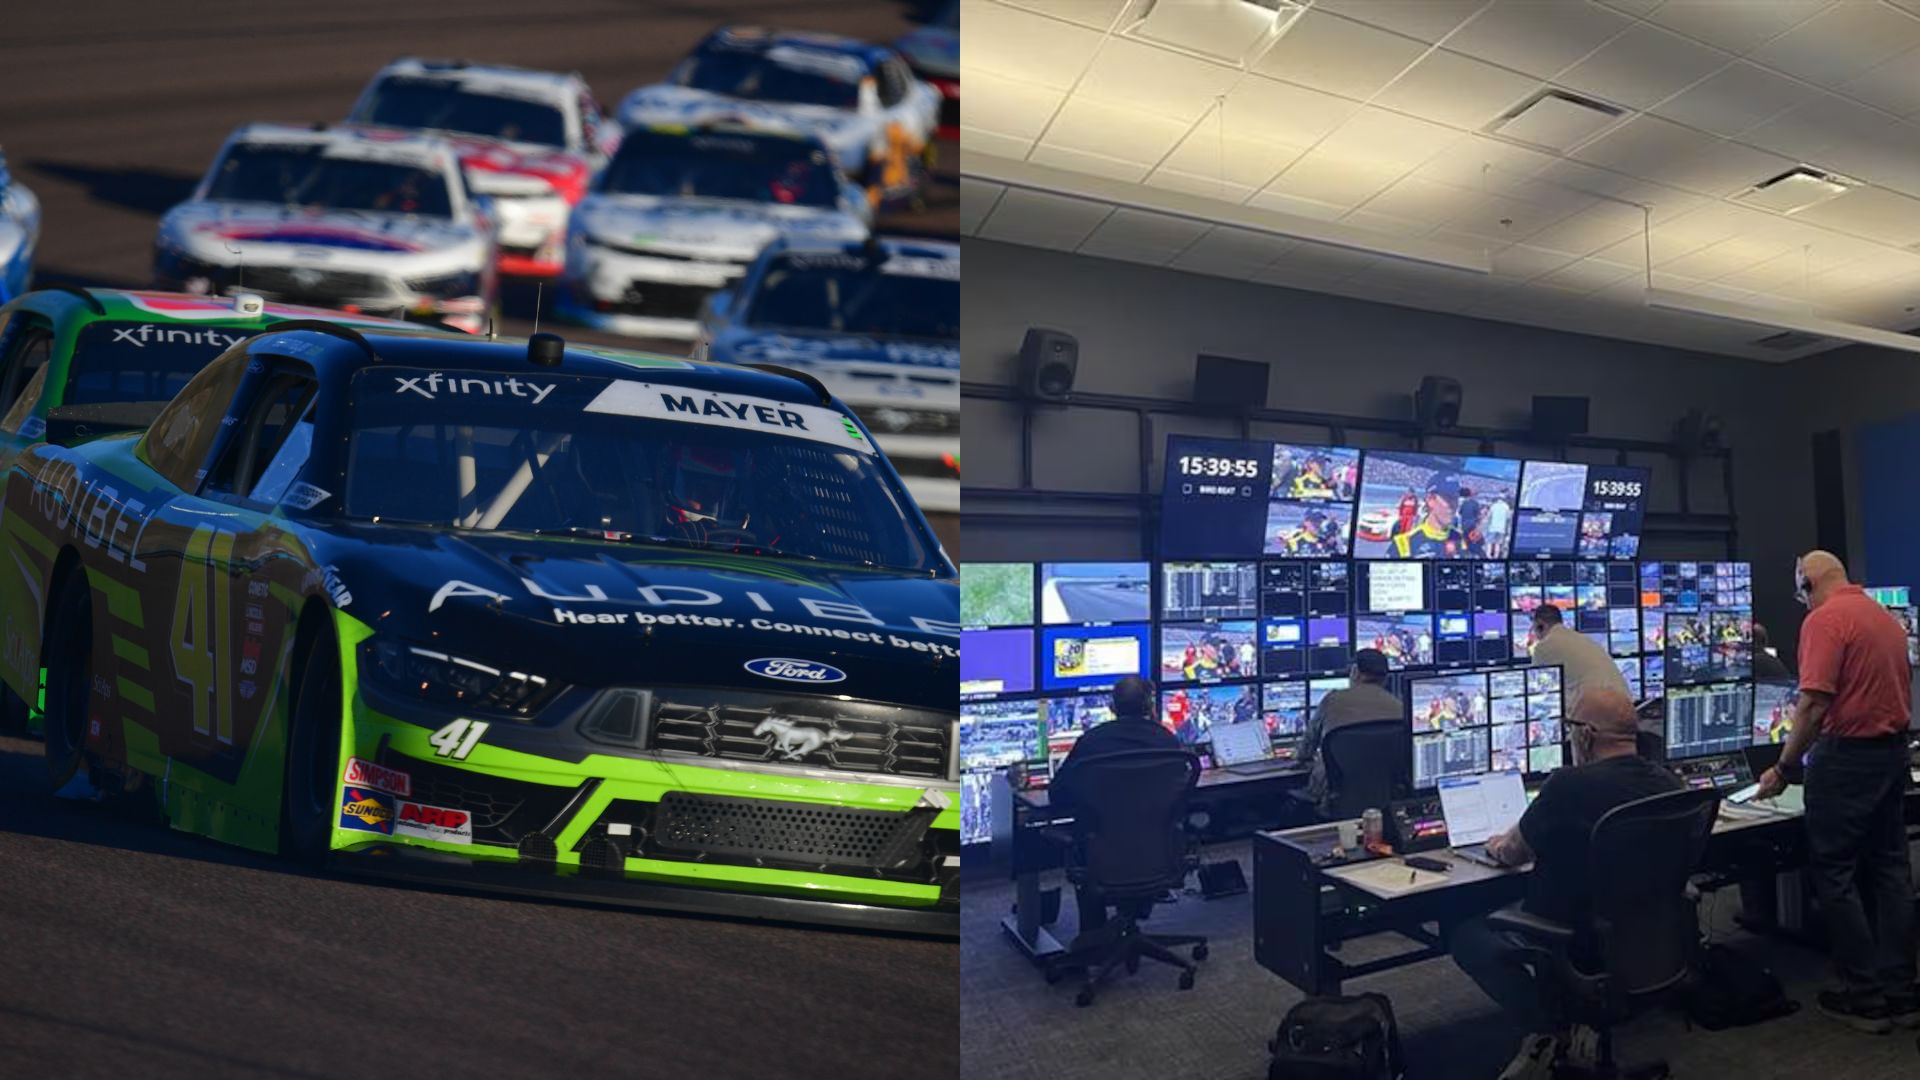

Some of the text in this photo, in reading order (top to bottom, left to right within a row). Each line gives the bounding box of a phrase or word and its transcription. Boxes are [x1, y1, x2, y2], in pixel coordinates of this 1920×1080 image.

[112, 324, 247, 352] xfinity
[396, 372, 557, 404] xfinity
[661, 393, 810, 432] MAYER
[1179, 456, 1258, 478] 15:39:55
[170, 521, 237, 745] 41
[554, 607, 629, 627] Hear
[635, 609, 744, 630] better.
[751, 618, 885, 645] Connect
[764, 658, 828, 681] Ford
[429, 717, 492, 761] 41
[349, 760, 408, 794] SIMPSON
[400, 802, 469, 829] ARP
